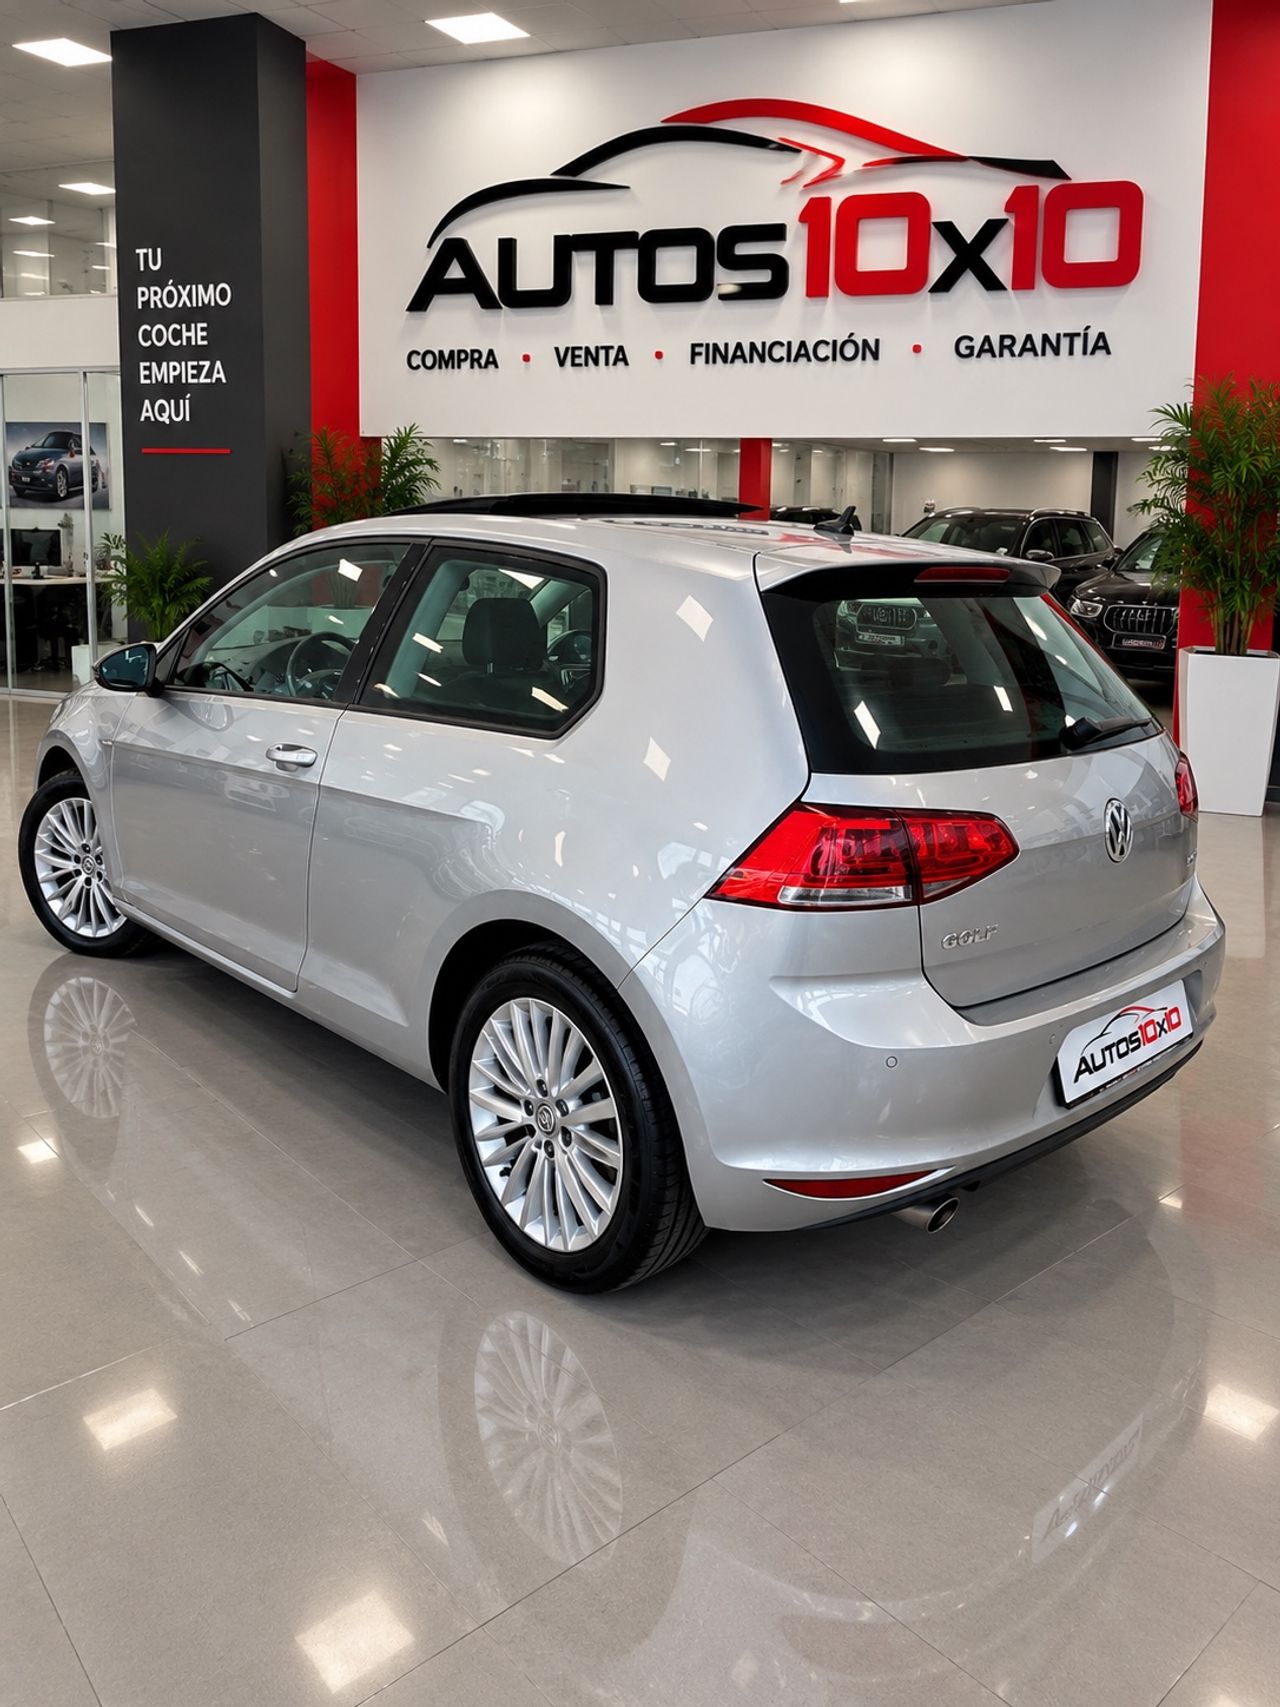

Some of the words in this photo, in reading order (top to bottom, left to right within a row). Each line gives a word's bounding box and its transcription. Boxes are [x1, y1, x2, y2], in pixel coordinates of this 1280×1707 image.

[136, 247, 162, 272] TU
[406, 181, 1144, 312] AUTOS10x10
[137, 280, 232, 310] PRÓXIMO
[138, 322, 208, 347] COCHE
[406, 348, 499, 371] COMPRA
[554, 345, 630, 368] VENTA
[690, 332, 880, 365] FINANCIACIÓN
[954, 325, 1112, 359] GARANTÍA
[139, 360, 227, 384] EMPIEZA
[140, 395, 191, 425] AQUÍ
[1073, 1006, 1183, 1084] AUTOS10x10
